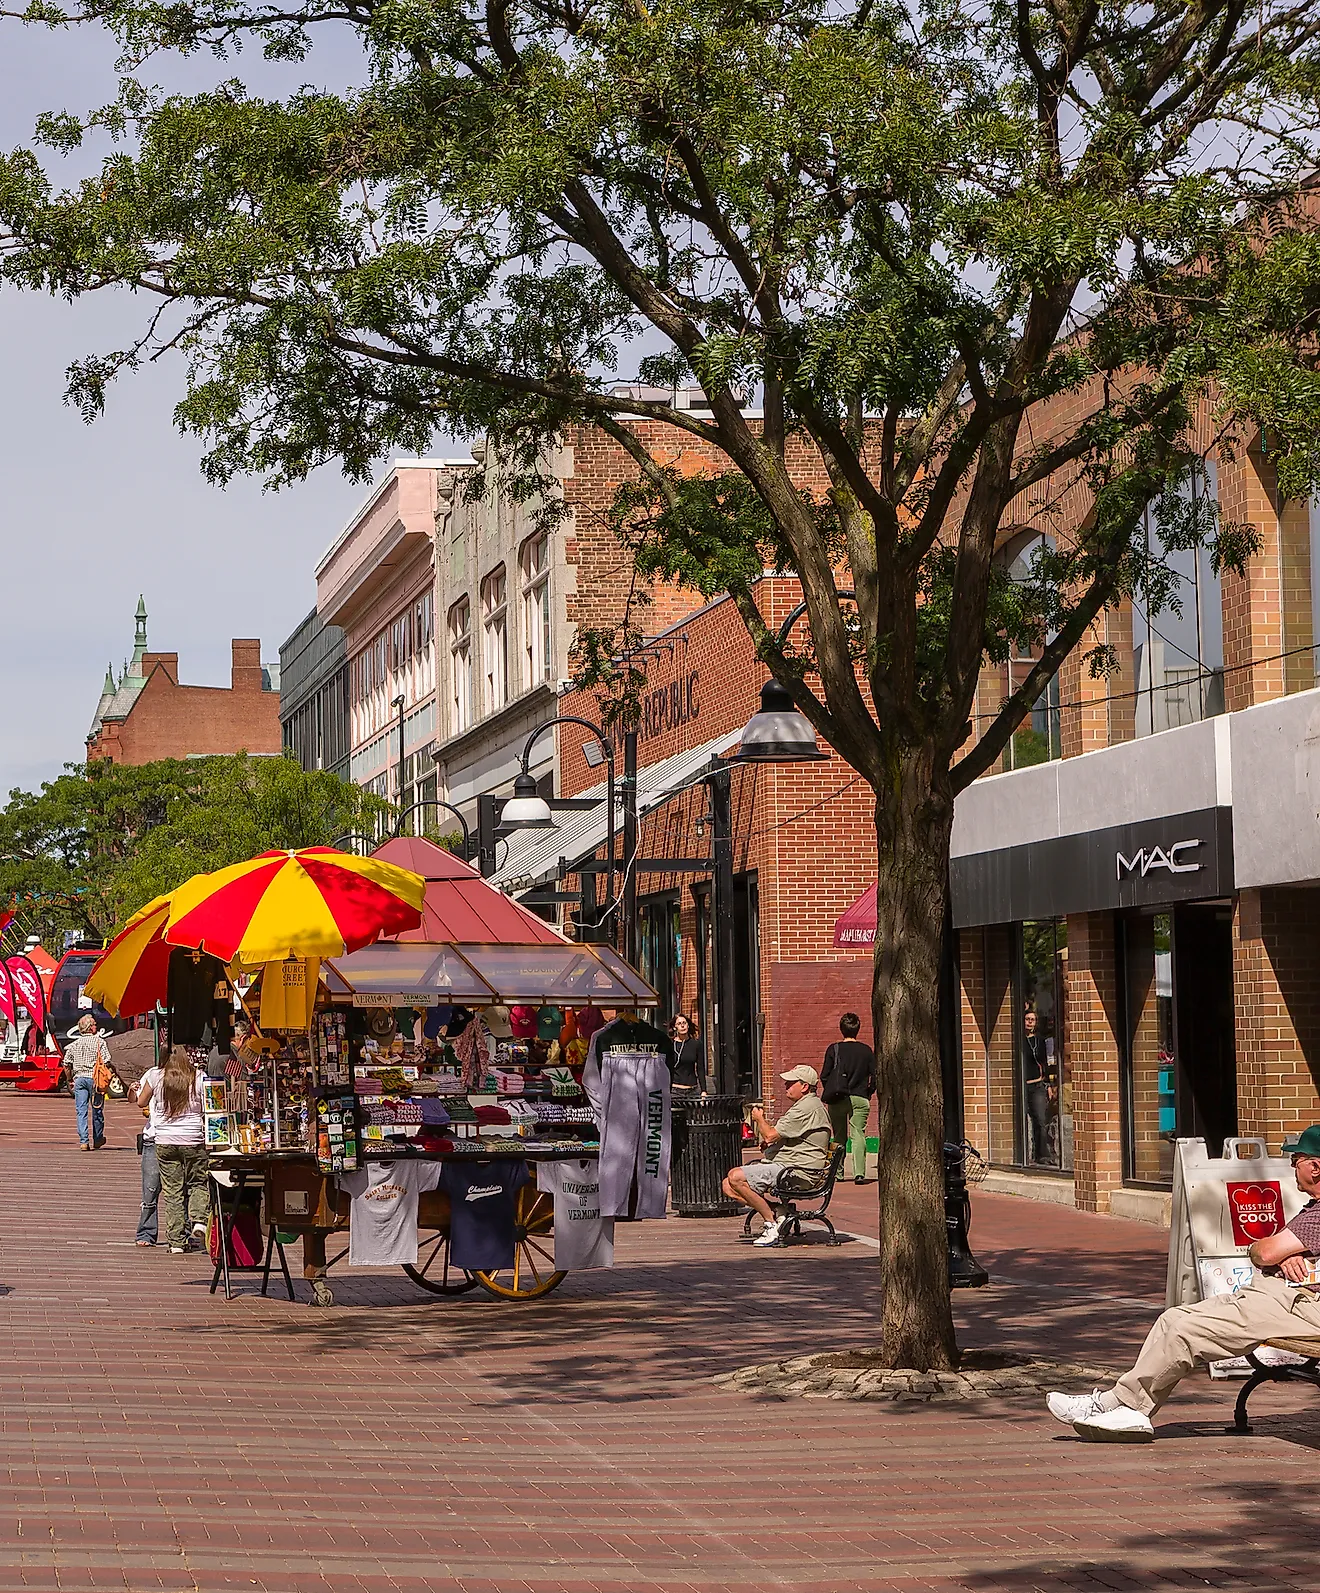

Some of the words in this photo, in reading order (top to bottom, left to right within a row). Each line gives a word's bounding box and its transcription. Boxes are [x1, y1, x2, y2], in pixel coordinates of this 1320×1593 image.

[643, 670, 700, 740] REPUBLIC
[645, 1088, 663, 1178] VERMONT
[579, 1196, 588, 1207] OF
[1240, 1203, 1257, 1211] KISS
[567, 1208, 601, 1221] VERMONT
[1238, 1212, 1278, 1223] COOK
